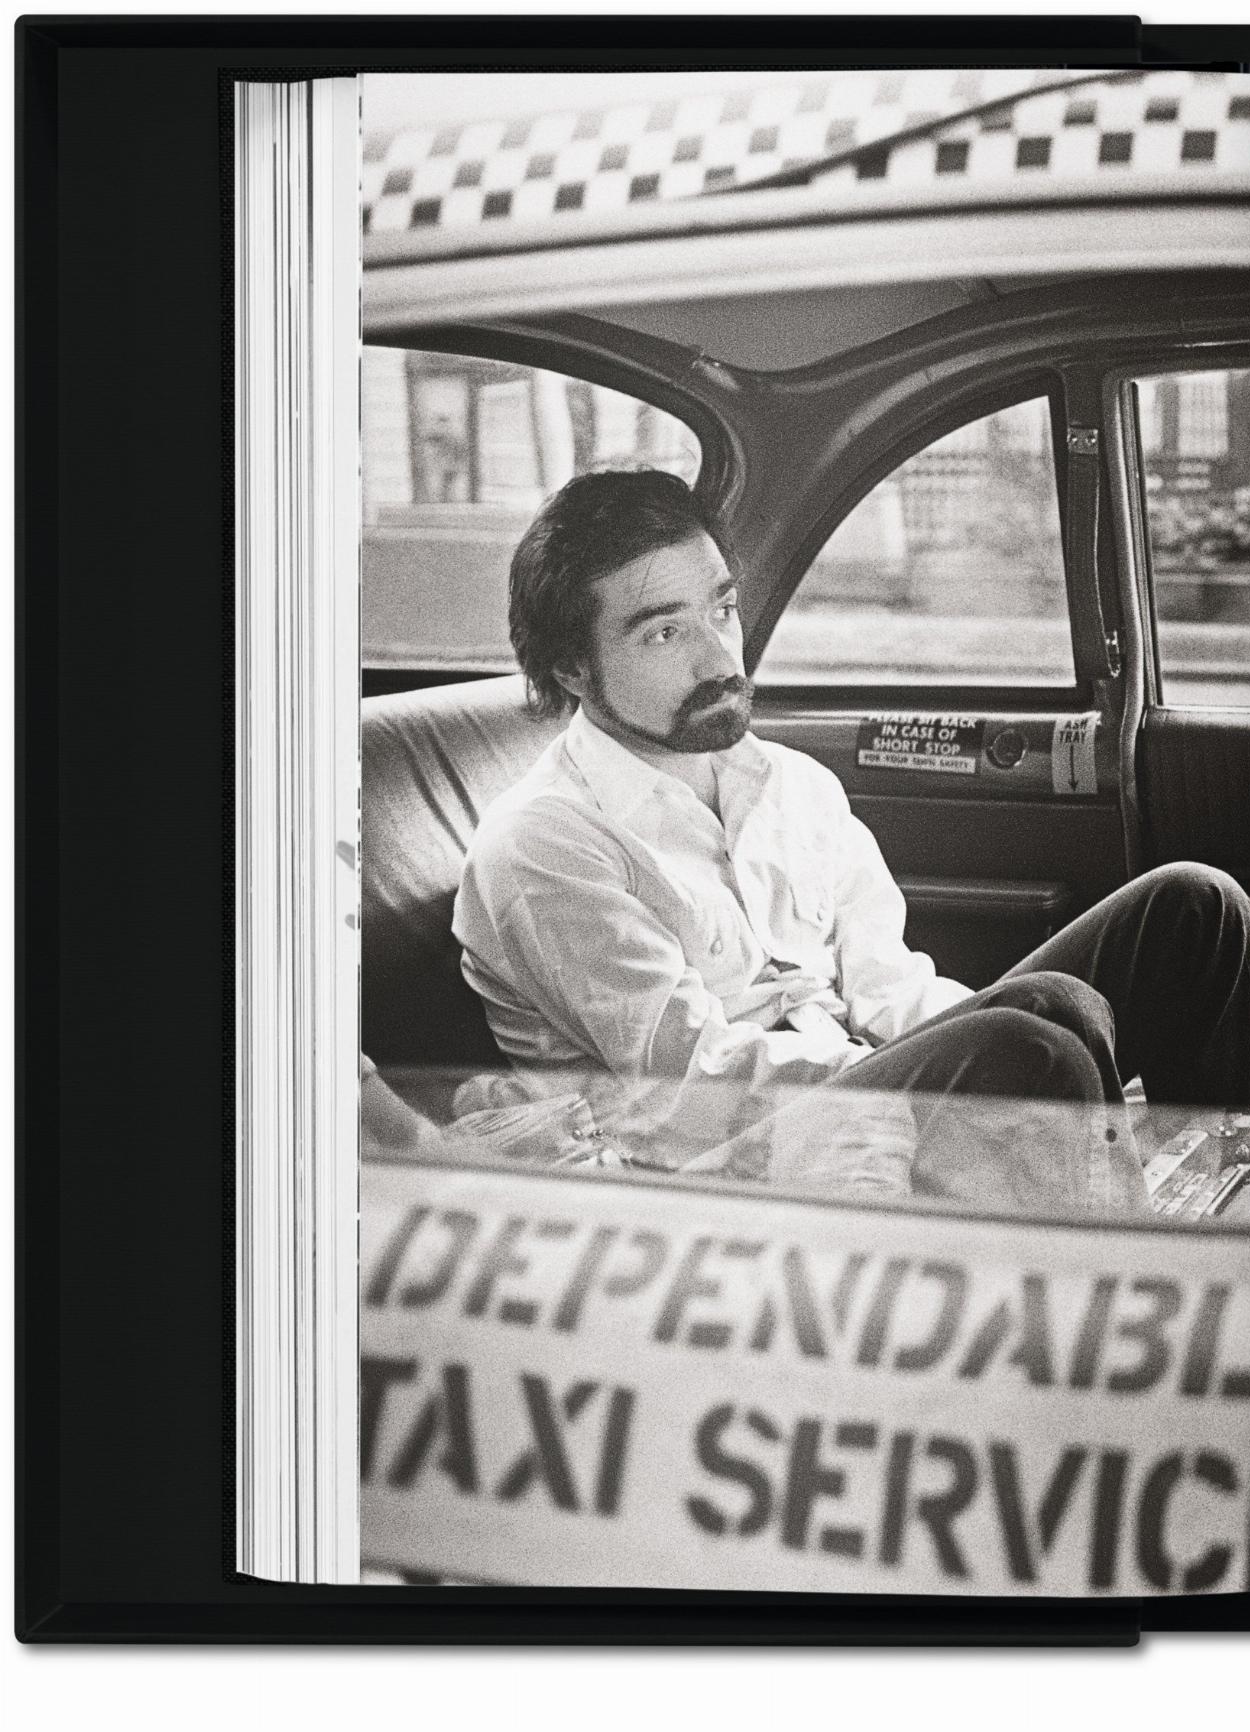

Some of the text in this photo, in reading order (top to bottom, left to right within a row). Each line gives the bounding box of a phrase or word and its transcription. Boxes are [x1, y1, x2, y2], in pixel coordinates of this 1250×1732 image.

[881, 725, 957, 741] IN CASE OF
[1059, 730, 1087, 744] TRAY
[873, 736, 961, 756] SHORT STOP
[360, 1352, 636, 1519] TAXI
